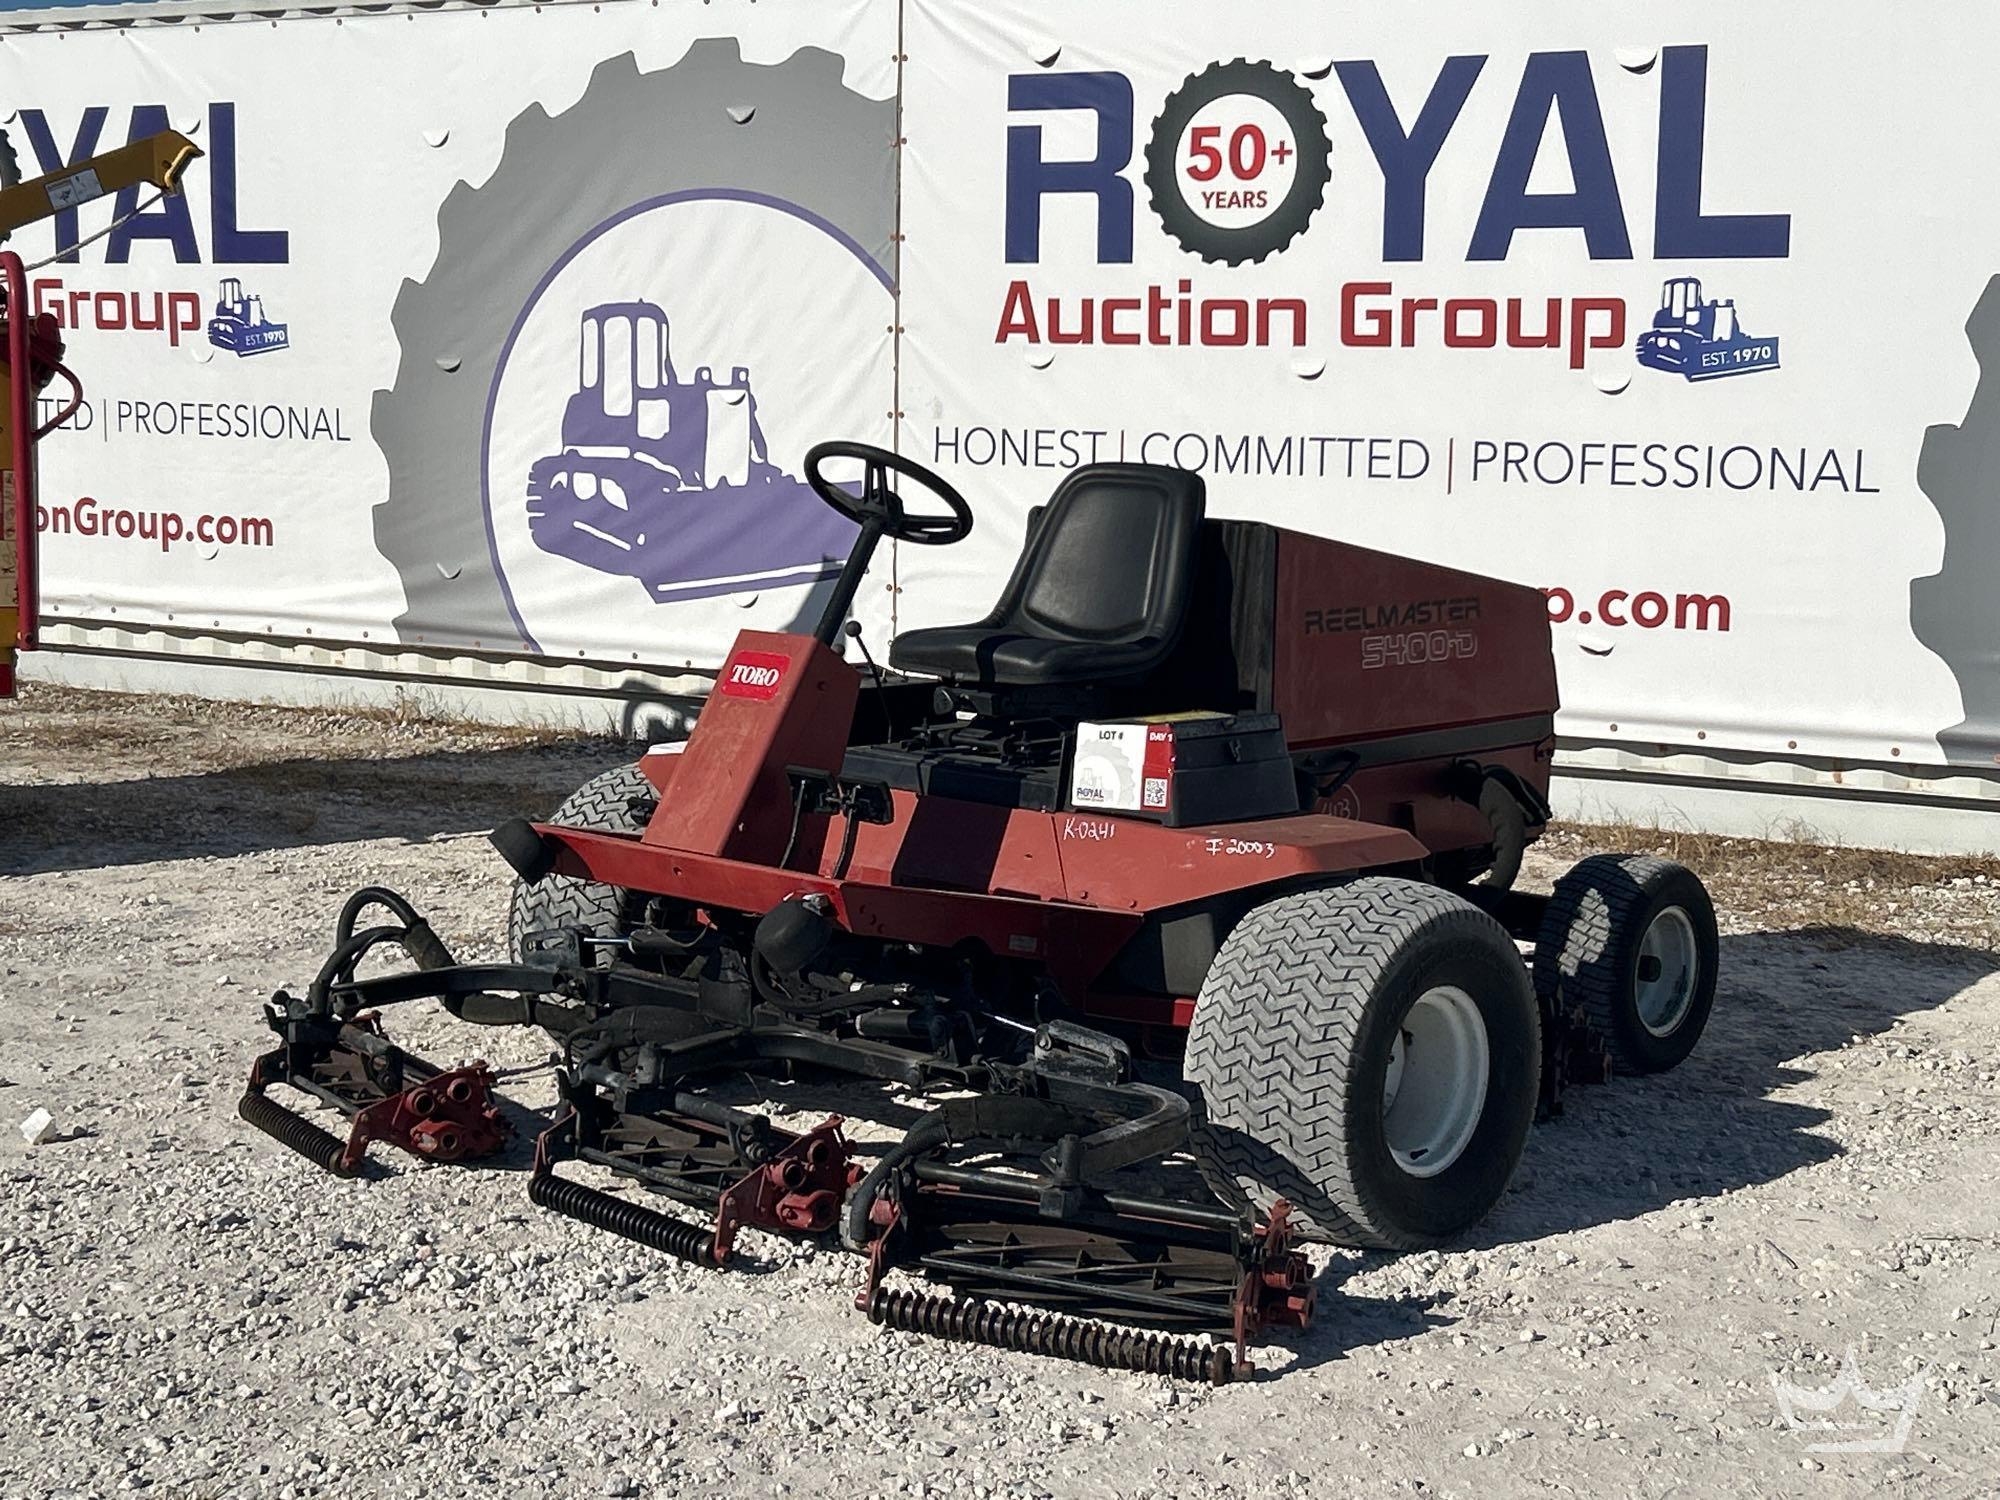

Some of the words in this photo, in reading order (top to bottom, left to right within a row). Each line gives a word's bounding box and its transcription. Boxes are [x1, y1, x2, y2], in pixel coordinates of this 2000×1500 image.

[1005, 44, 1791, 265] ROYAL
[1186, 123, 1293, 182] 50+
[0, 102, 289, 264] YAL
[1201, 190, 1269, 210] YEARS
[33, 278, 202, 347] Group
[995, 279, 1306, 348] Auction
[1340, 281, 1627, 370] Group
[245, 334, 262, 347] EST.
[263, 330, 286, 344] 1970
[1701, 351, 1730, 368] EST.
[1732, 345, 1772, 364] 1970
[117, 400, 351, 442] PROFESSIONAL
[934, 426, 1107, 469] HONEST
[1141, 432, 1431, 481] COMMITTED
[1474, 440, 1880, 494] PROFESSIONAL
[37, 496, 274, 552] onGroup.com
[1305, 597, 1481, 635] REELMASTER
[1538, 587, 1731, 632] p.com
[1361, 630, 1478, 670] 5400-D
[730, 664, 780, 687] TORO
[1098, 730, 1117, 741] LOT
[1149, 732, 1166, 743] DAY
[1076, 787, 1105, 799] ROYAL
